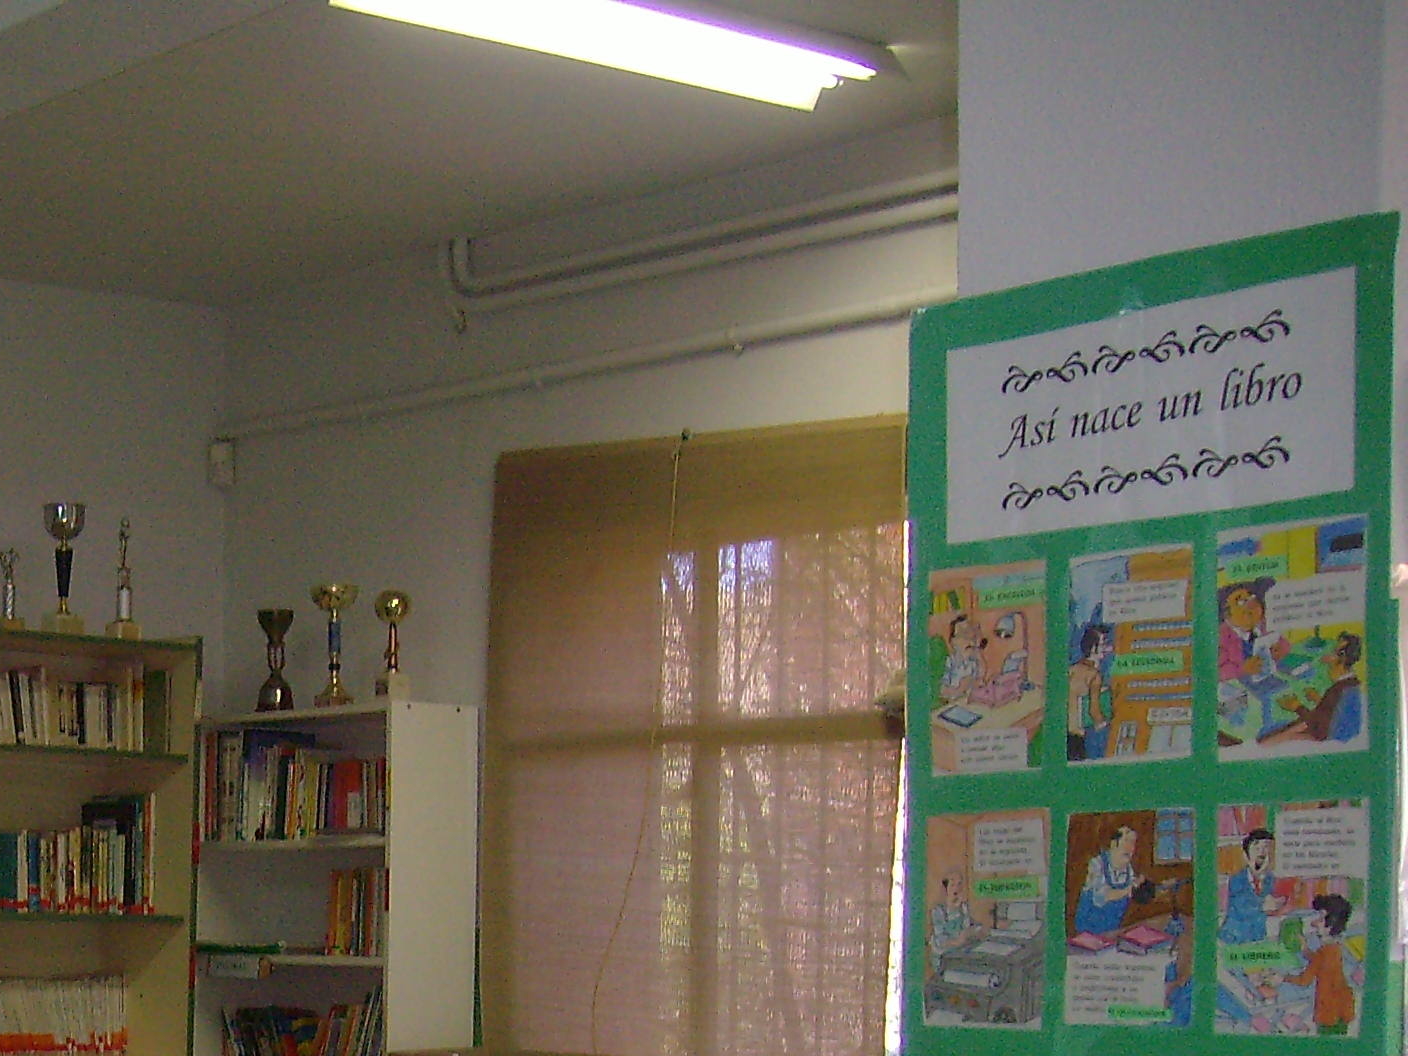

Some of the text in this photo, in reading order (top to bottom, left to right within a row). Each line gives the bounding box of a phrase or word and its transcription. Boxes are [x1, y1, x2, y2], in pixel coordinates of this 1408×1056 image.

[998, 362, 1303, 459] Así nace un libro
